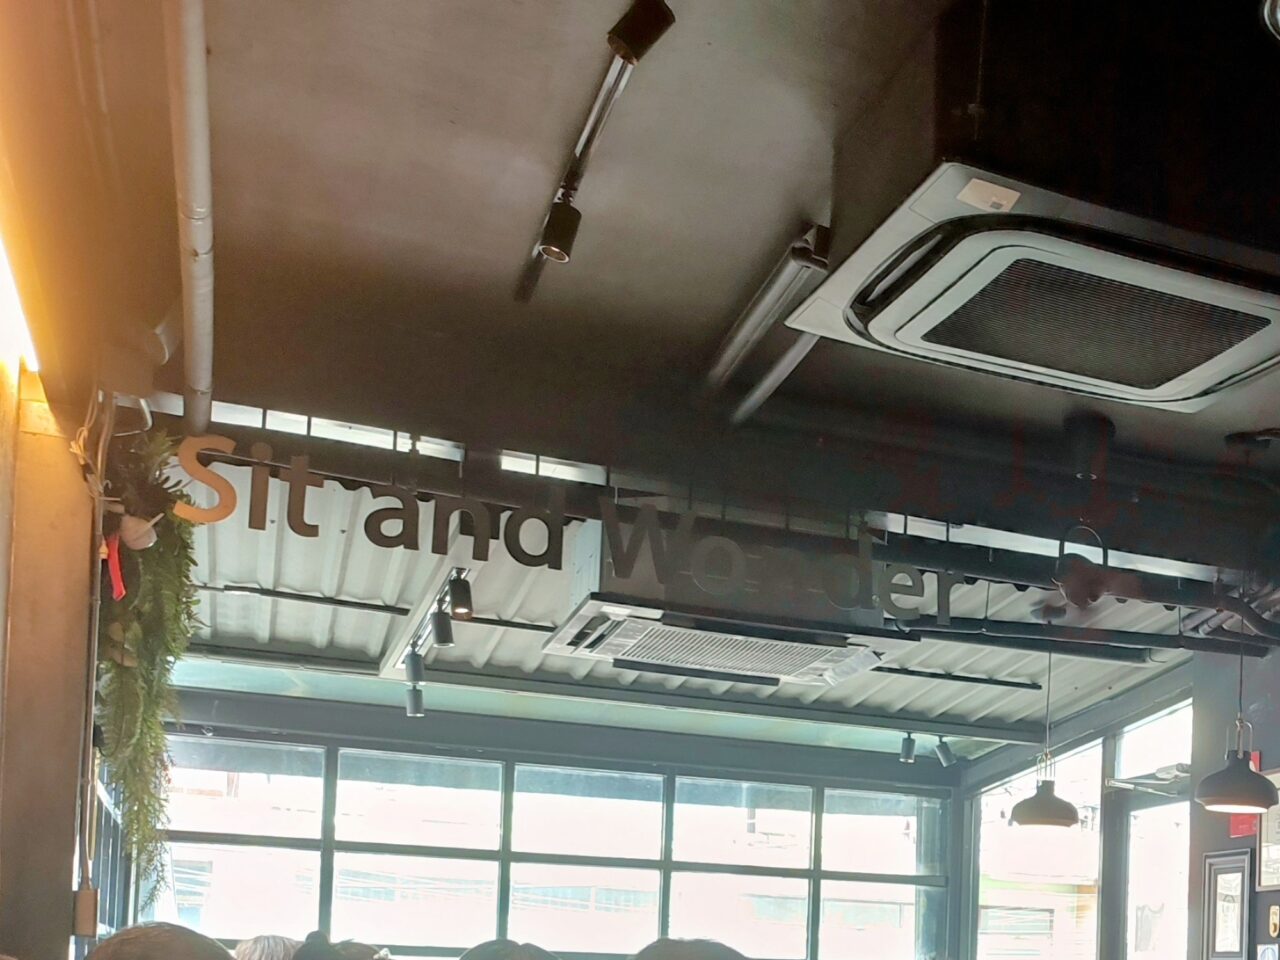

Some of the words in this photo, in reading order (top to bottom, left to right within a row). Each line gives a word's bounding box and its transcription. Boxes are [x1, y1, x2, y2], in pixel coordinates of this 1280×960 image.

[173, 434, 325, 538] Sit
[364, 482, 565, 571] and
[599, 494, 965, 626] Woder
